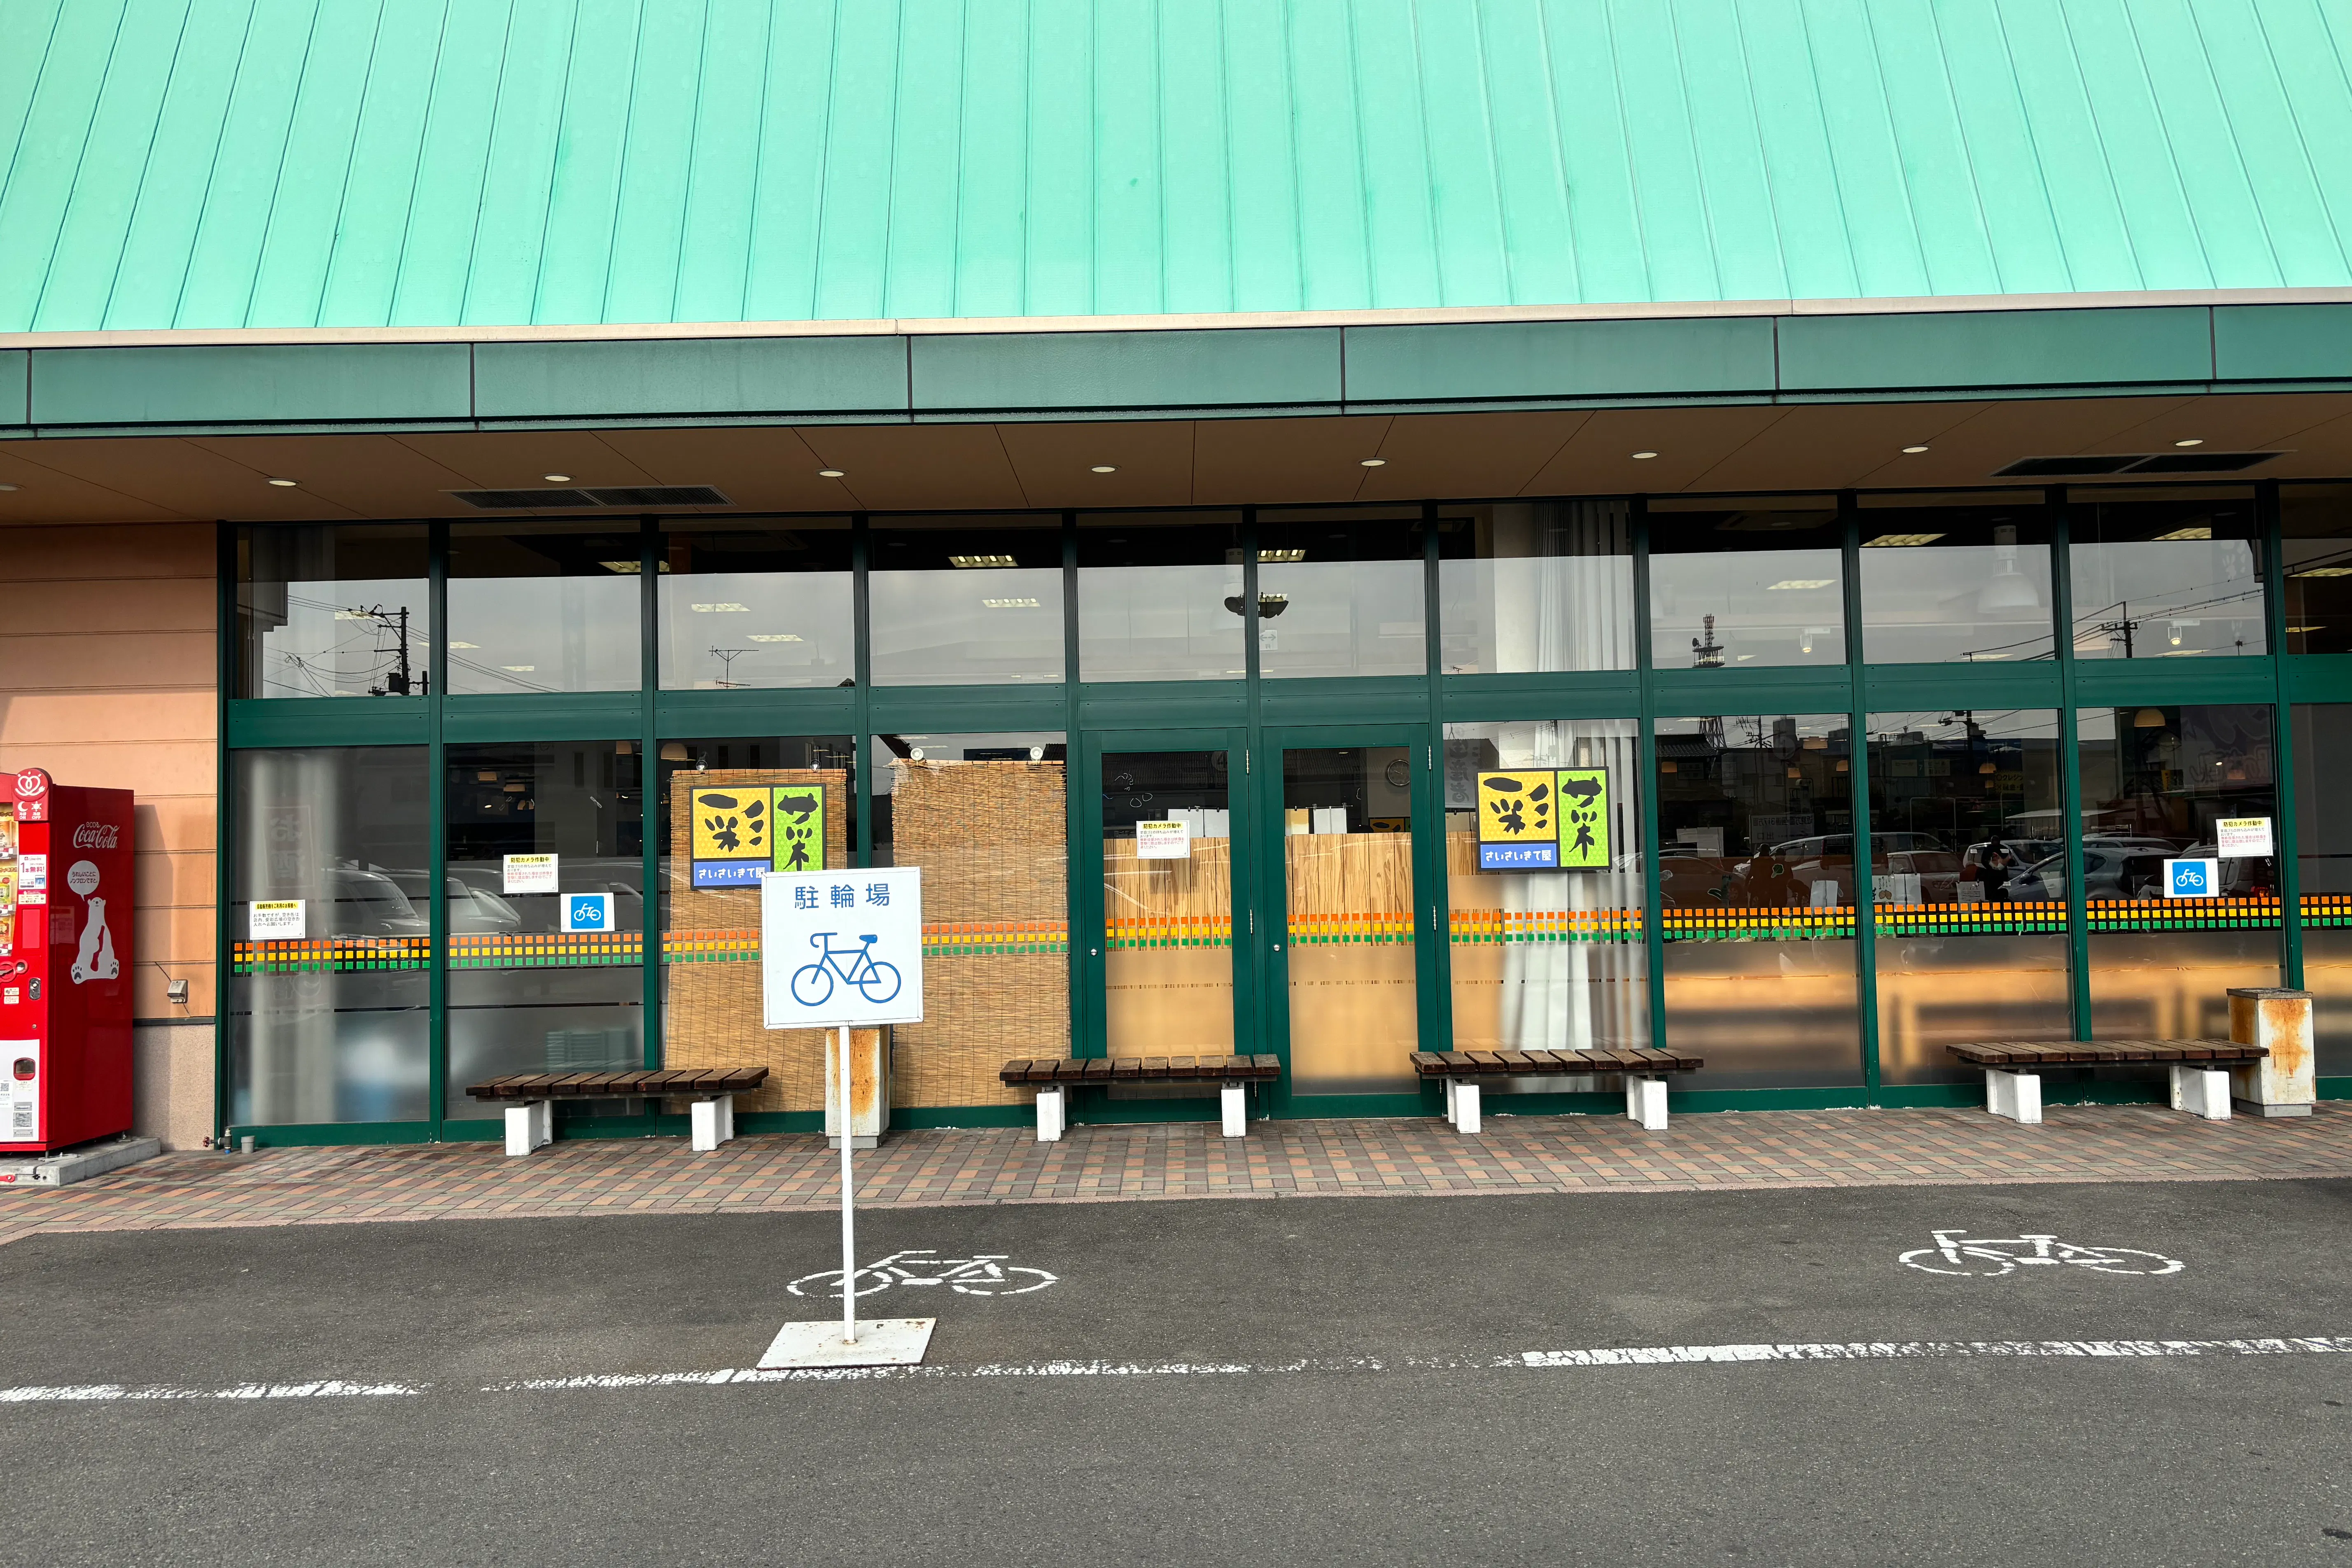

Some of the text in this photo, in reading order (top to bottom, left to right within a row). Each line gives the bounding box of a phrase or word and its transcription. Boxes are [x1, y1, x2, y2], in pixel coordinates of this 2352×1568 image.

[1486, 850, 1552, 862] さいさいきて屋
[795, 883, 890, 909] 駐輪場
